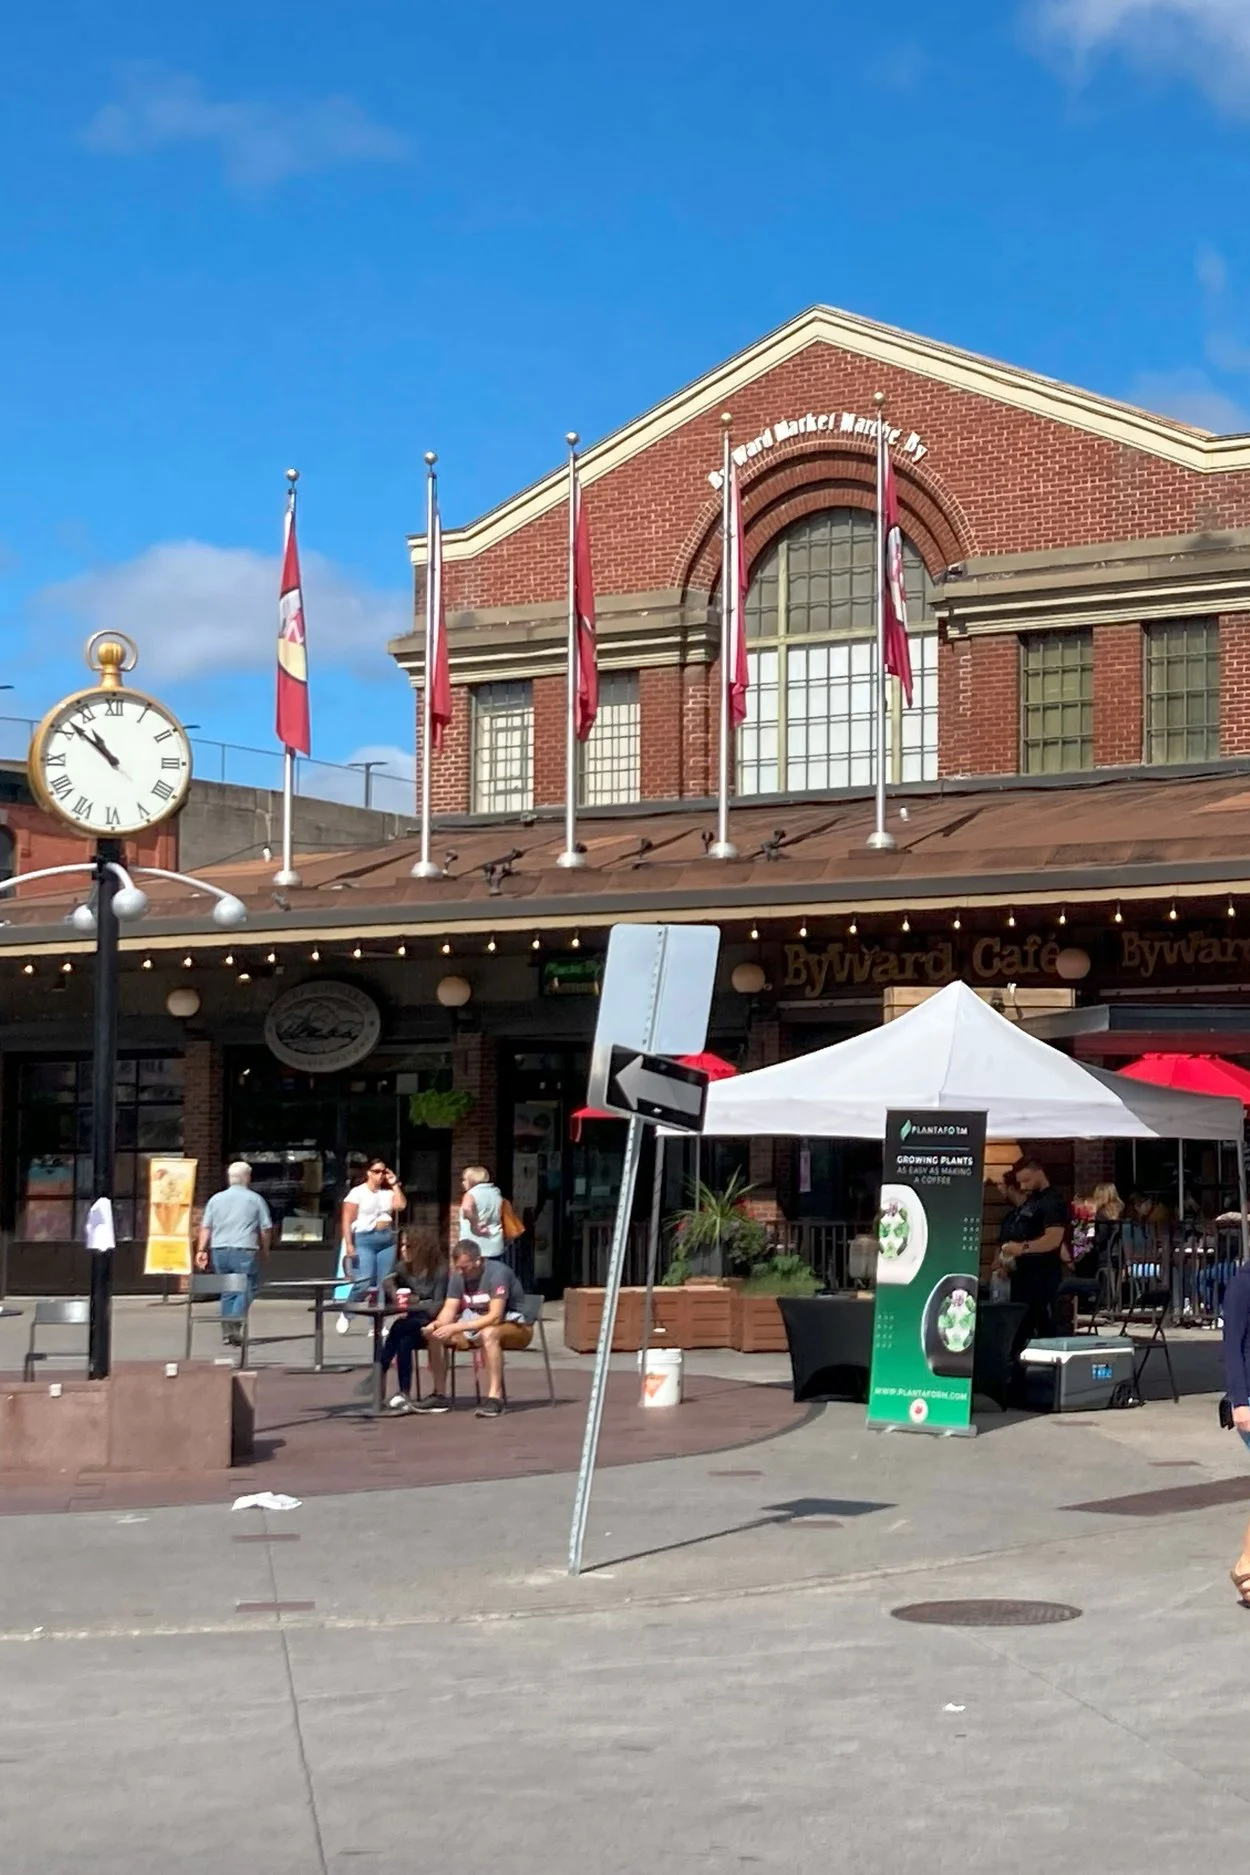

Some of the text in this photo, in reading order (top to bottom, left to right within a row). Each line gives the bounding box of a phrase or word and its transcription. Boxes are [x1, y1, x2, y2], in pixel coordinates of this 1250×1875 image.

[731, 429, 773, 467] Ward
[773, 412, 836, 443] Market
[903, 431, 929, 464] By
[784, 932, 1060, 997] ByWard Café
[911, 1125, 968, 1136] PLANTAFORM
[896, 1155, 974, 1166] GROWING PLANTS
[896, 1166, 907, 1174] AS
[908, 1166, 928, 1175] EASY
[940, 1167, 972, 1177] MAKING
[921, 1176, 951, 1185] COFFEE
